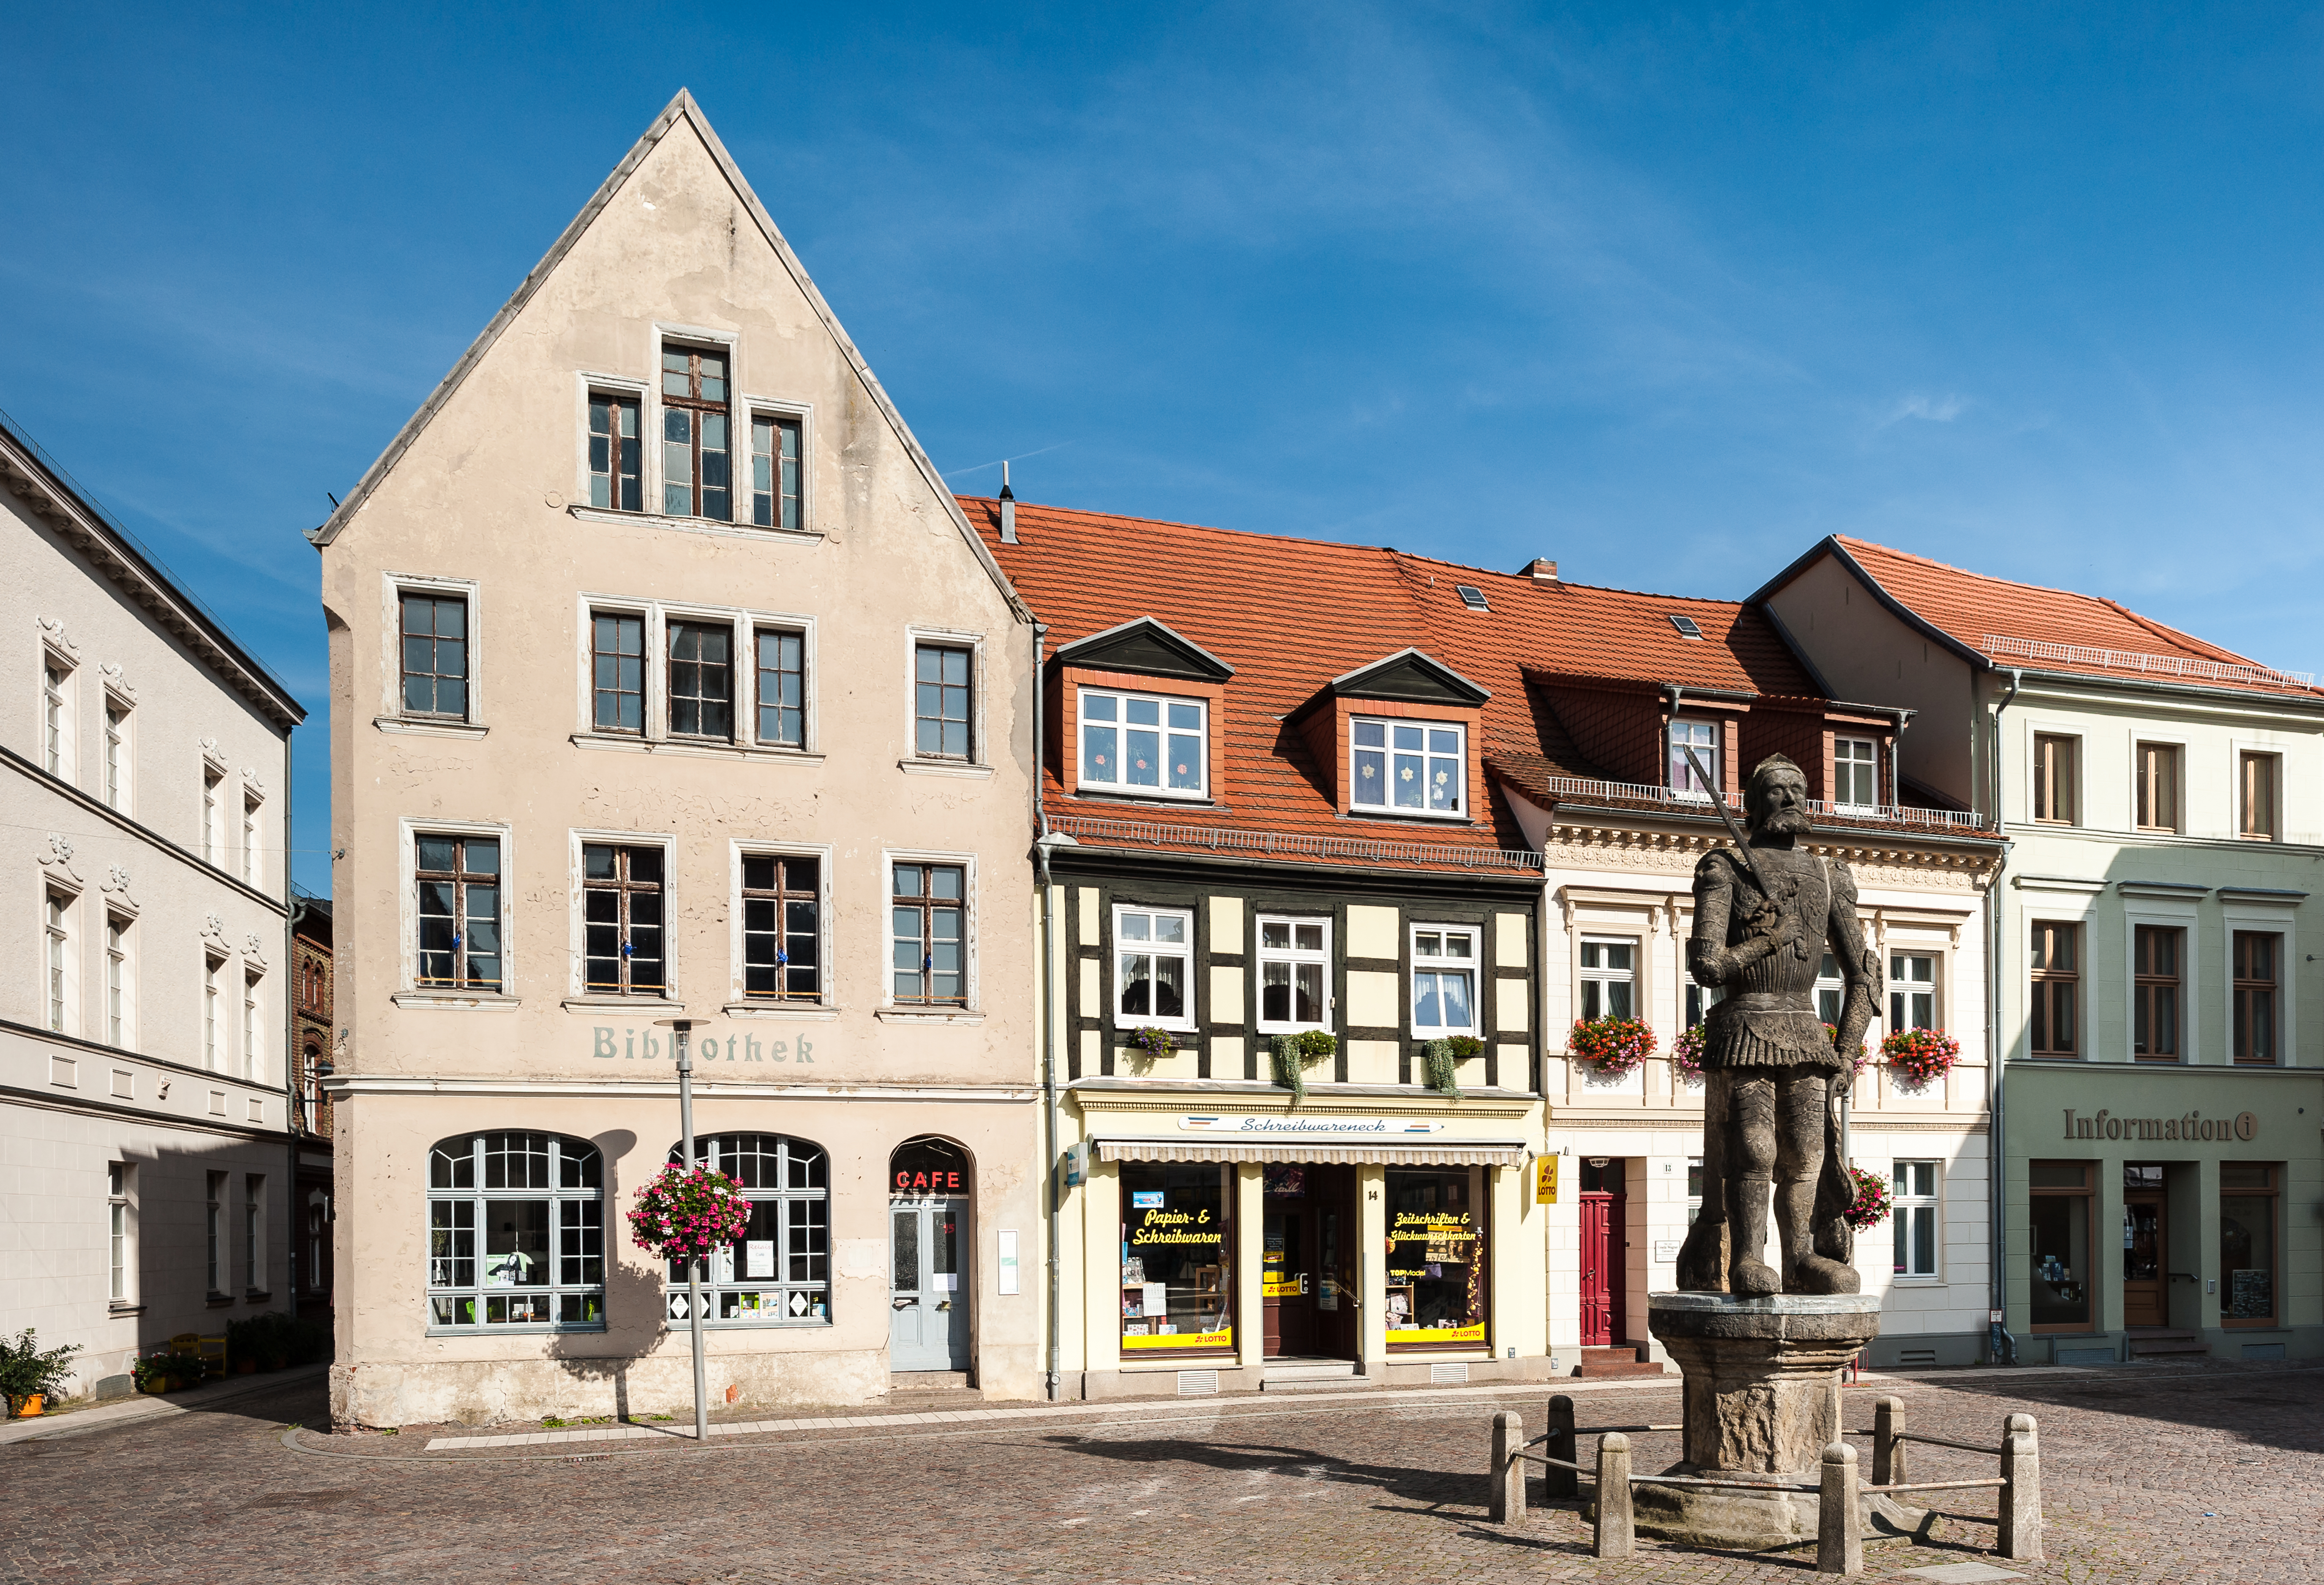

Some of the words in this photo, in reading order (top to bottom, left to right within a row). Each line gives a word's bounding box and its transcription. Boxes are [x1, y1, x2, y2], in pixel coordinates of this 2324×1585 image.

[593, 1027, 814, 1063] Biblothek
[1241, 1118, 1386, 1131] Schreibwareneck
[2063, 1109, 2233, 1140] Information
[897, 1171, 960, 1188] CAFE
[1368, 1191, 1378, 1201] 14
[1538, 1186, 1556, 1195] LOTTO
[1144, 1209, 1194, 1227] Papier-
[1198, 1209, 1210, 1224] &
[1394, 1212, 1459, 1227] Zeitschriften
[1460, 1212, 1470, 1224] &
[1133, 1228, 1221, 1245] Schreibwaren
[1390, 1230, 1476, 1242] Glückwunschkarten
